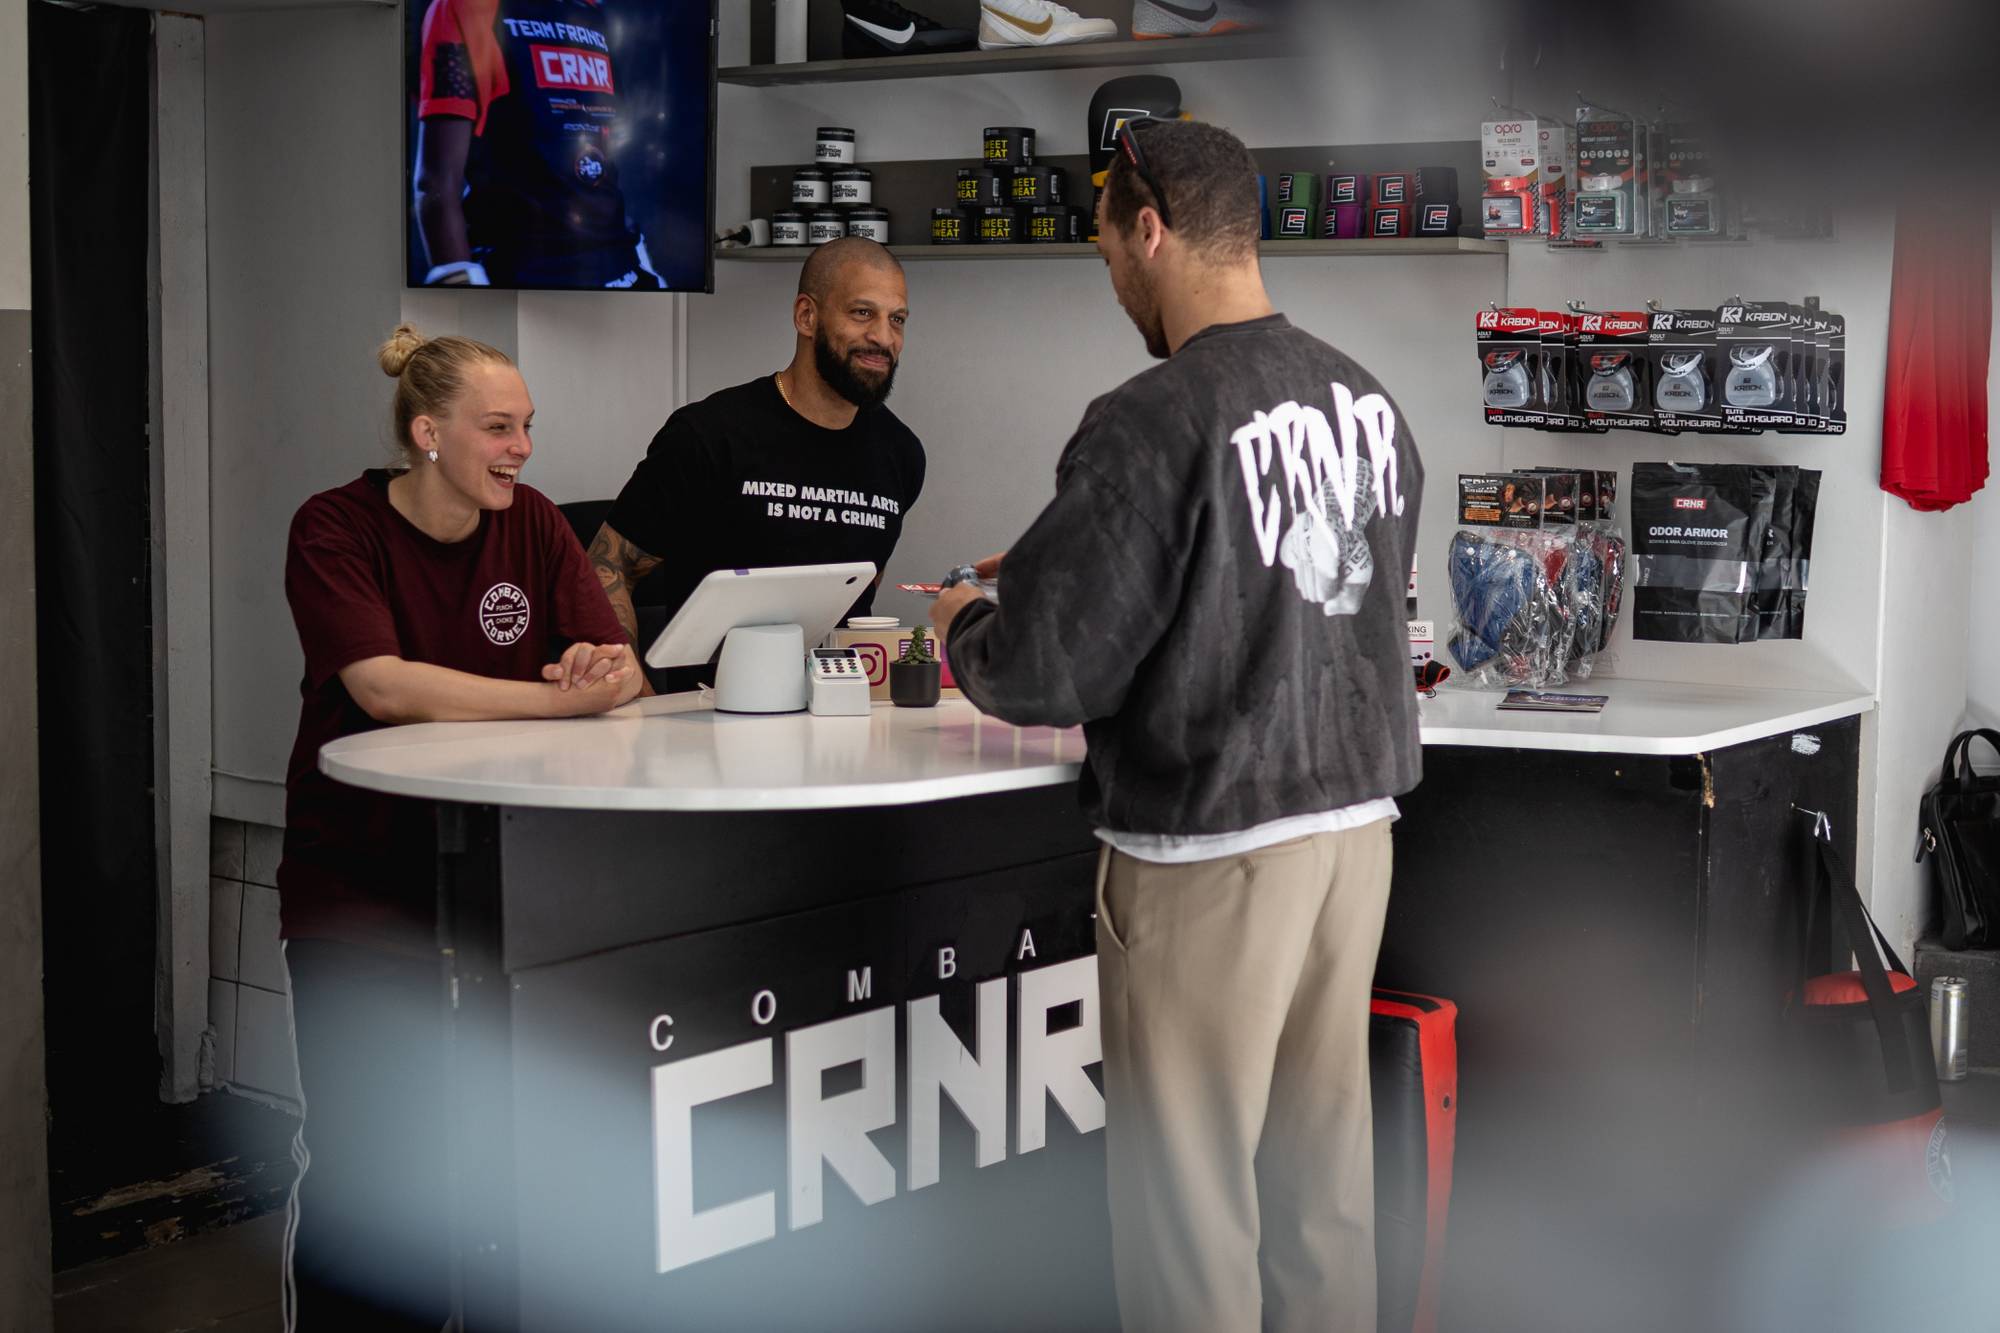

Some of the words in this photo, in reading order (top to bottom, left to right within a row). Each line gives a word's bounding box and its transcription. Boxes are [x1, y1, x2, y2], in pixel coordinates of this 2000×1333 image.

[503, 18, 557, 39] TEAM
[555, 22, 608, 52] FRANC
[540, 50, 611, 88] CRNR
[1012, 177, 1037, 187] WEET
[1012, 187, 1037, 196] WEAT
[1489, 415, 1544, 423] MOUTHGUARD
[1589, 419, 1649, 427] MOUTHGUARD
[1660, 419, 1720, 428] MOUTHGUARD
[1727, 415, 1793, 423] MOUTHGUARD
[742, 481, 797, 498] MIXED
[801, 486, 868, 506] MARTIAL
[871, 495, 900, 515] ARTS
[1676, 499, 1704, 509] CRNR
[767, 502, 784, 517] IS
[788, 504, 822, 521] NOT
[824, 508, 837, 523] A
[841, 510, 886, 530] CRIME
[1649, 527, 1682, 537] ODOR
[1683, 528, 1728, 538] ARMOR
[484, 586, 526, 611] COMBAT
[485, 615, 527, 641] CORNER
[650, 928, 1036, 1051] COMBA
[651, 954, 1106, 1273] CRNR
